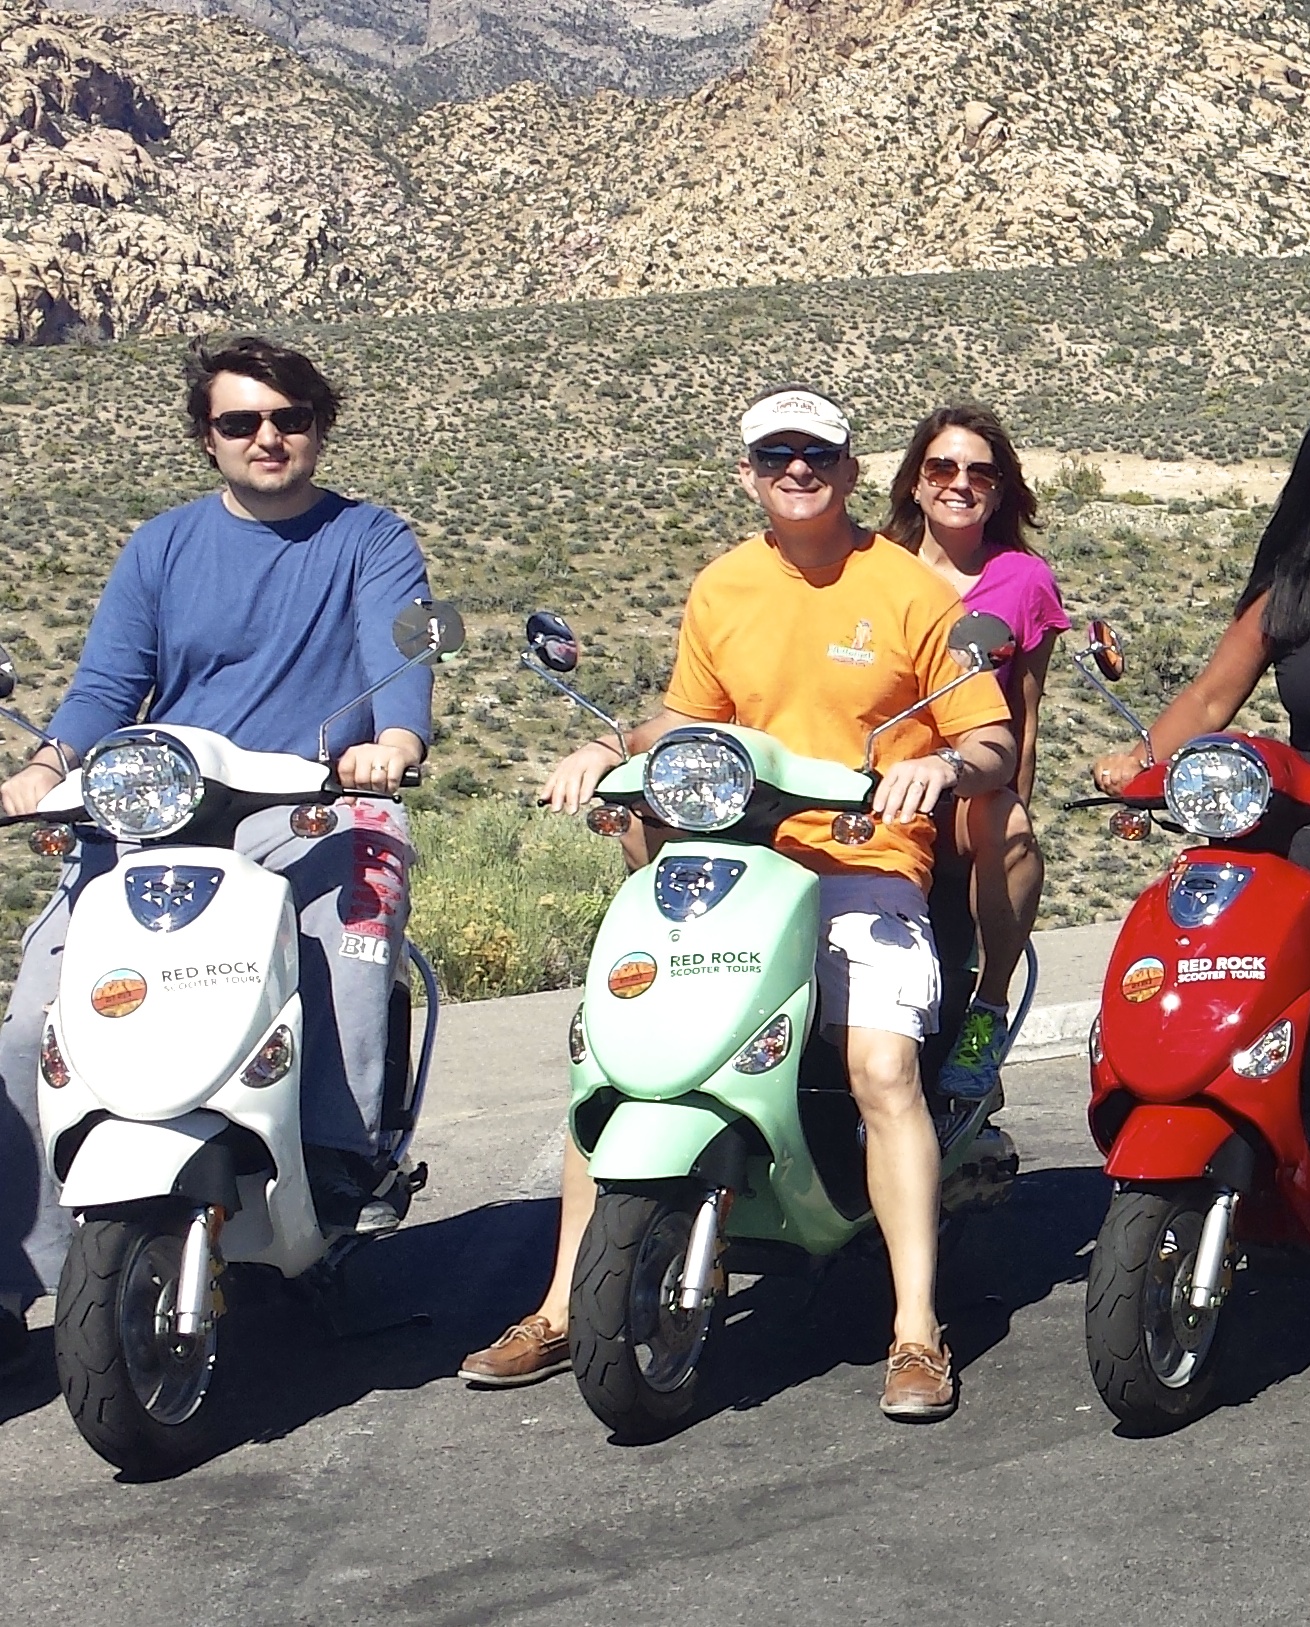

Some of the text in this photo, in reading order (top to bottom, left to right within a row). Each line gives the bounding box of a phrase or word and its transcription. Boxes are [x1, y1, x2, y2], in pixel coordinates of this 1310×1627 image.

[670, 952, 761, 967] RED ROCK
[1177, 957, 1266, 973] RED ROCK
[162, 962, 259, 982] RED ROCK
[670, 965, 762, 977] SCOOTER TOURS
[1177, 970, 1265, 983] SCOOTER TOURS
